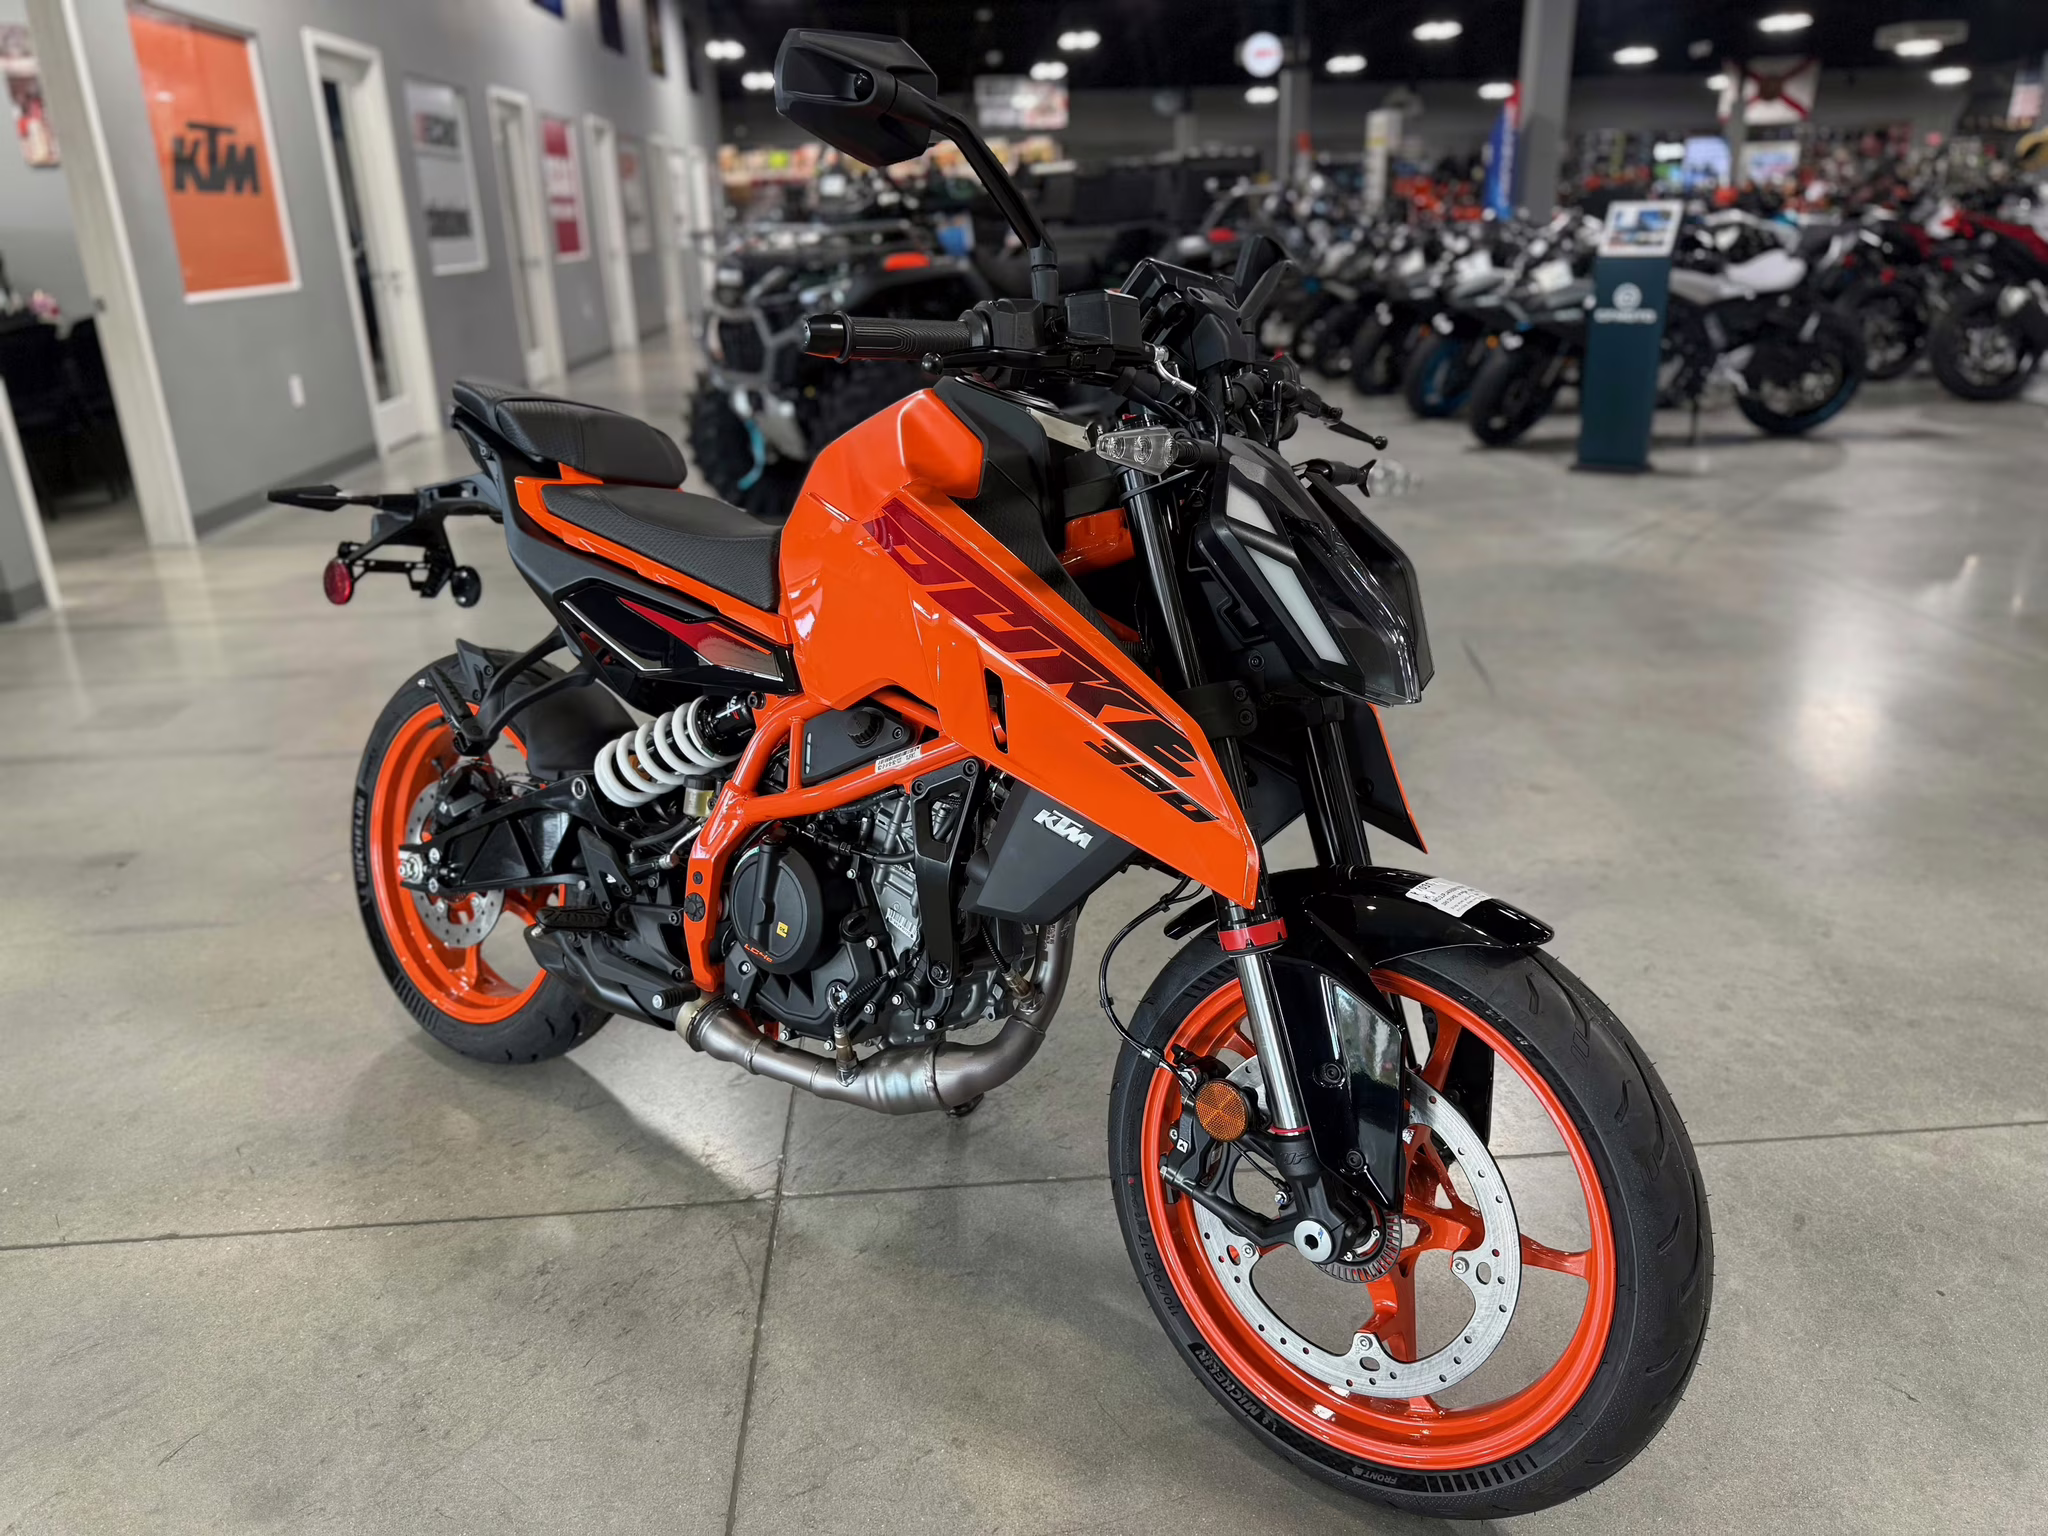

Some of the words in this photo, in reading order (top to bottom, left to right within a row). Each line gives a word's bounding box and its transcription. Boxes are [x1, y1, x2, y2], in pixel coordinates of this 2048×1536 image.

[174, 121, 260, 195] KTM
[862, 497, 1201, 778] DUKE
[355, 796, 366, 883] MICHELIN
[1033, 809, 1094, 849] KTM
[1137, 1234, 1150, 1249] 17
[1144, 1252, 1157, 1270] ZR
[1153, 1274, 1180, 1317] 110/70
[1363, 1470, 1398, 1485] FRONT
